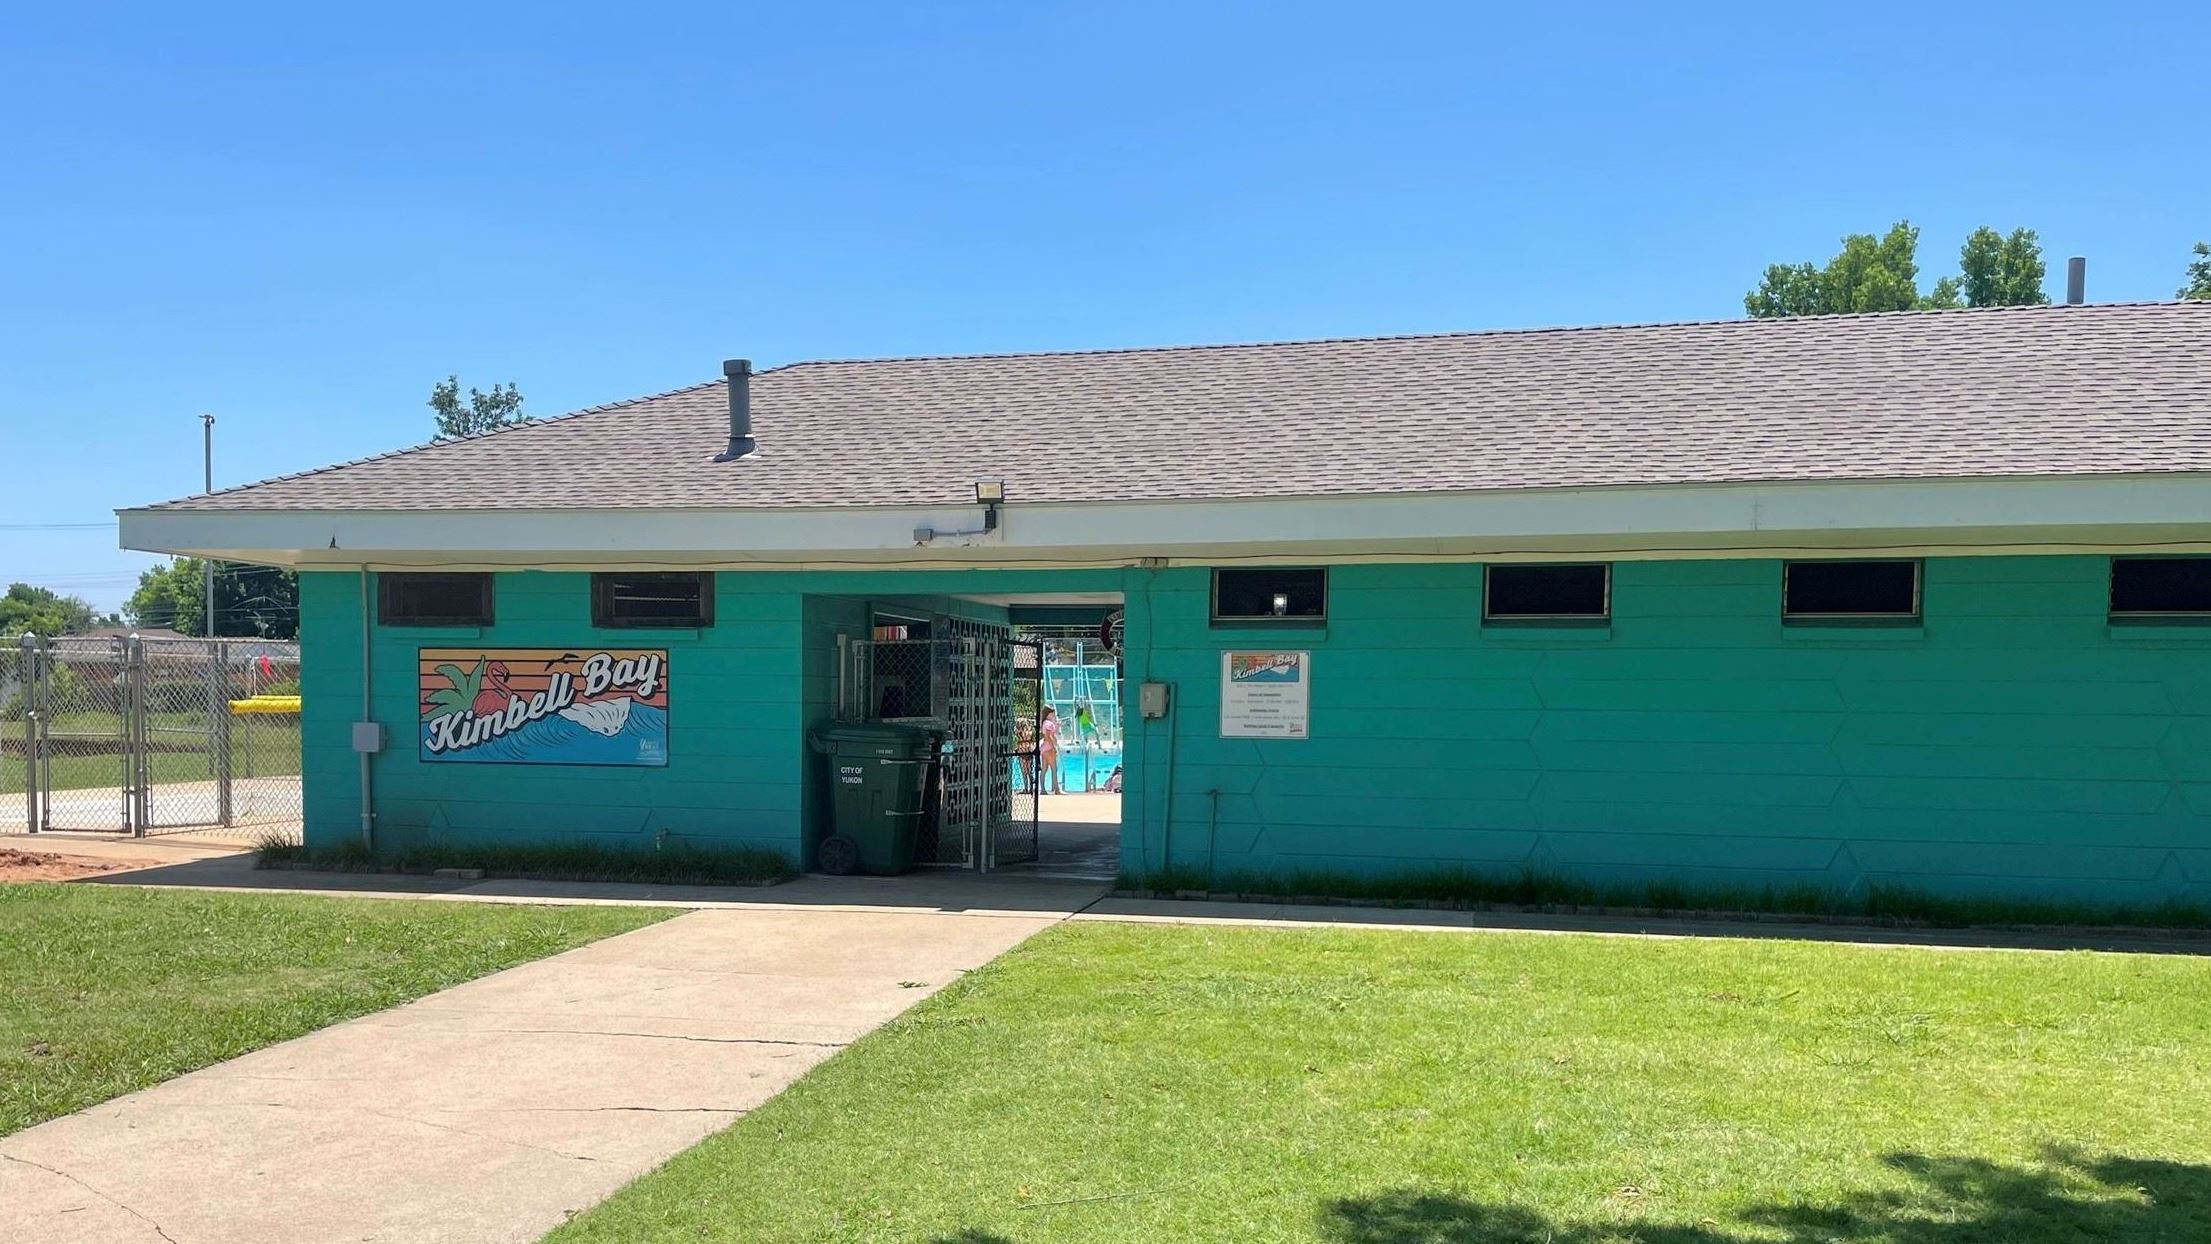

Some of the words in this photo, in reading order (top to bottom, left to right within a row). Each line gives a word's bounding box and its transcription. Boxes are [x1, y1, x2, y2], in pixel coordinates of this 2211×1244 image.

[1233, 660, 1273, 680] Kimbell
[1275, 654, 1297, 666] Bay
[425, 673, 574, 753] Kimbell
[581, 653, 660, 696] Bay
[840, 766, 854, 774] CITY
[855, 766, 863, 774] OF
[841, 776, 863, 784] YUKON
